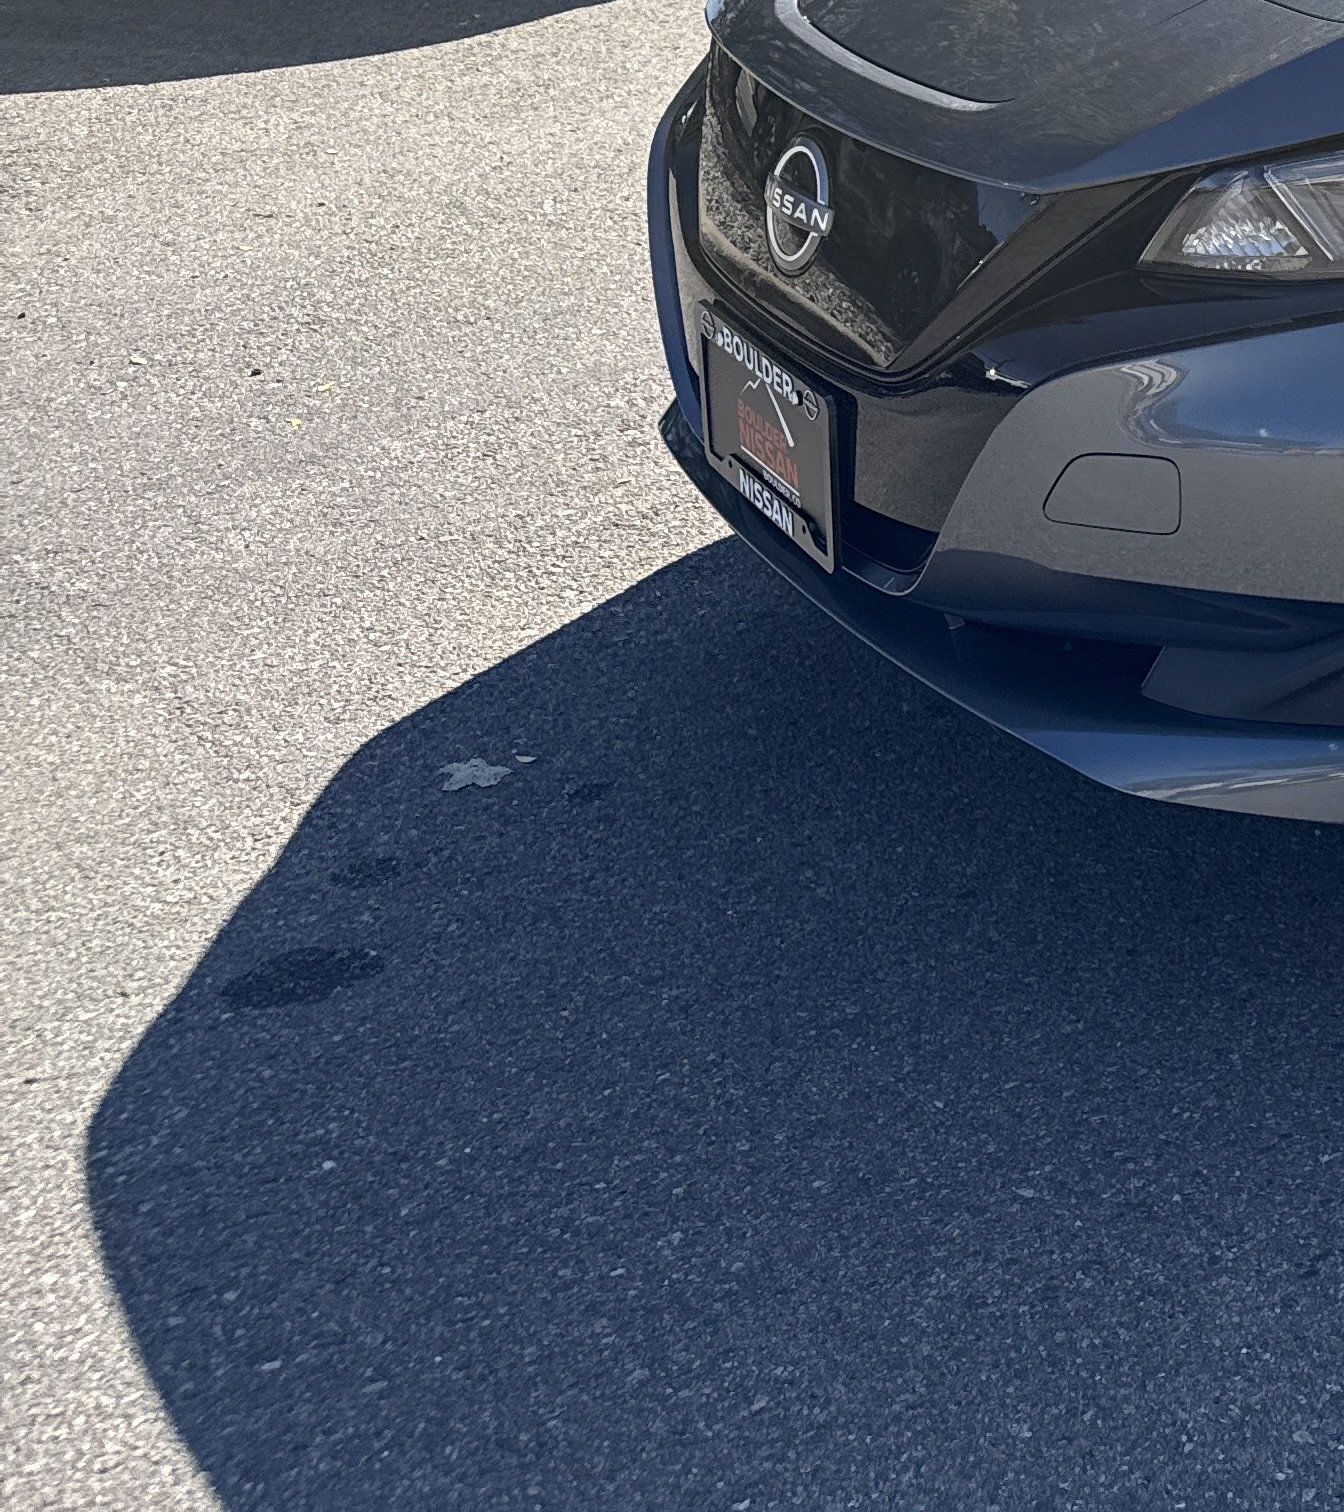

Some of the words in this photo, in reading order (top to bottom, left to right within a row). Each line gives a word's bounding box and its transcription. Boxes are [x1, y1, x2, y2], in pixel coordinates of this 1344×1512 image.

[722, 326, 793, 397] BOULDER
[737, 397, 787, 449] BOULDER
[738, 419, 799, 489] NISSAN
[739, 468, 794, 538] NISSAN
